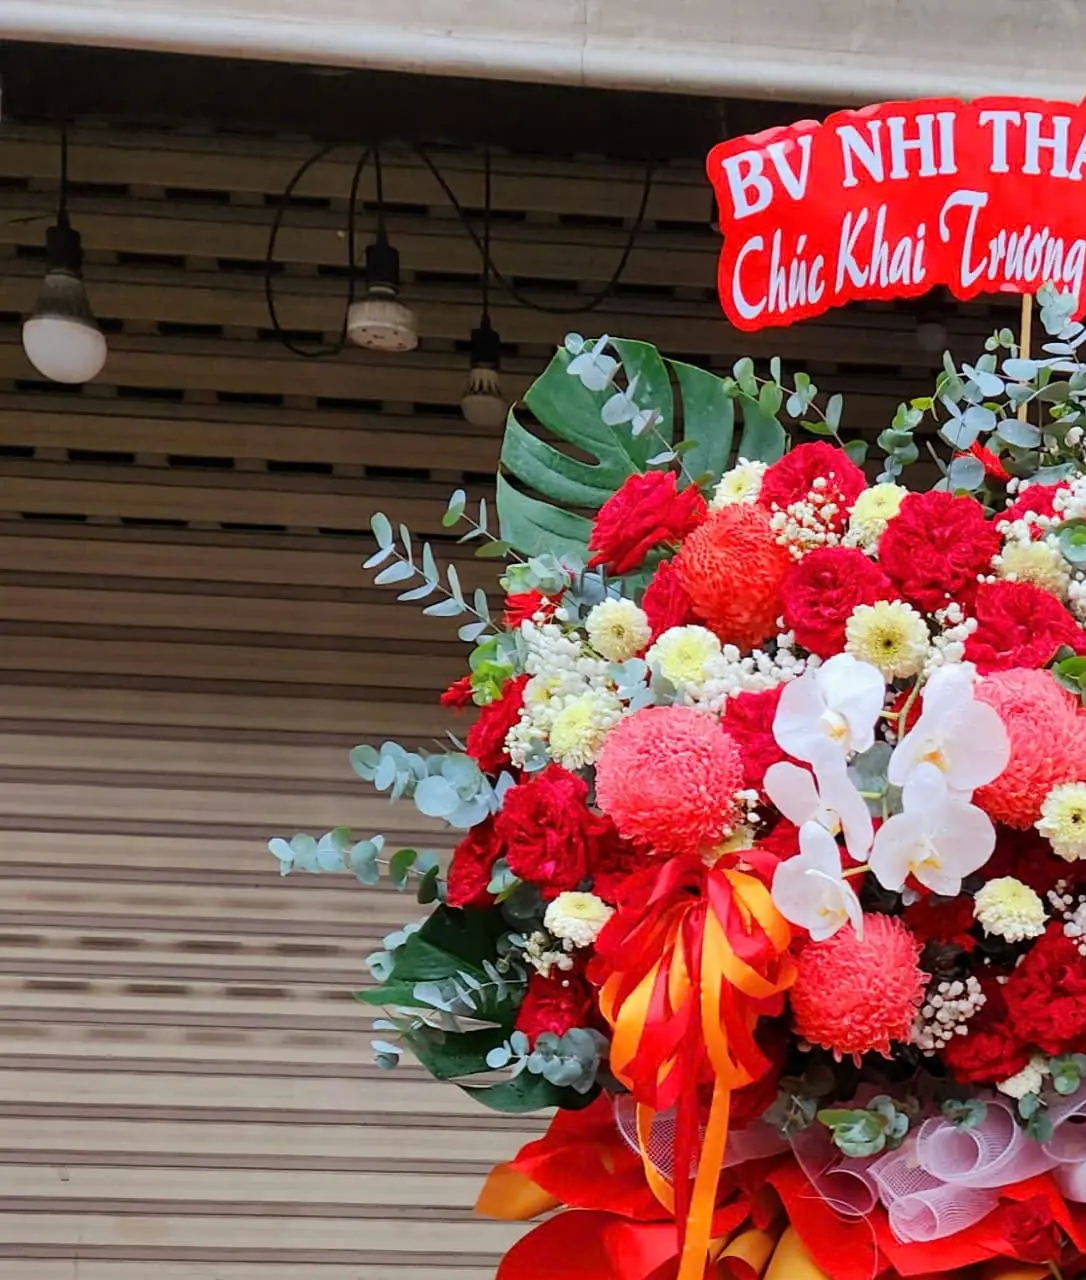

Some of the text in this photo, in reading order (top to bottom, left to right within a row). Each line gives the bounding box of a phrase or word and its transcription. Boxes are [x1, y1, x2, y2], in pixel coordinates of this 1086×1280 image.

[721, 134, 813, 220] BV
[835, 111, 958, 188] NHI
[732, 228, 825, 320] Chúc
[834, 203, 926, 295] Khai
